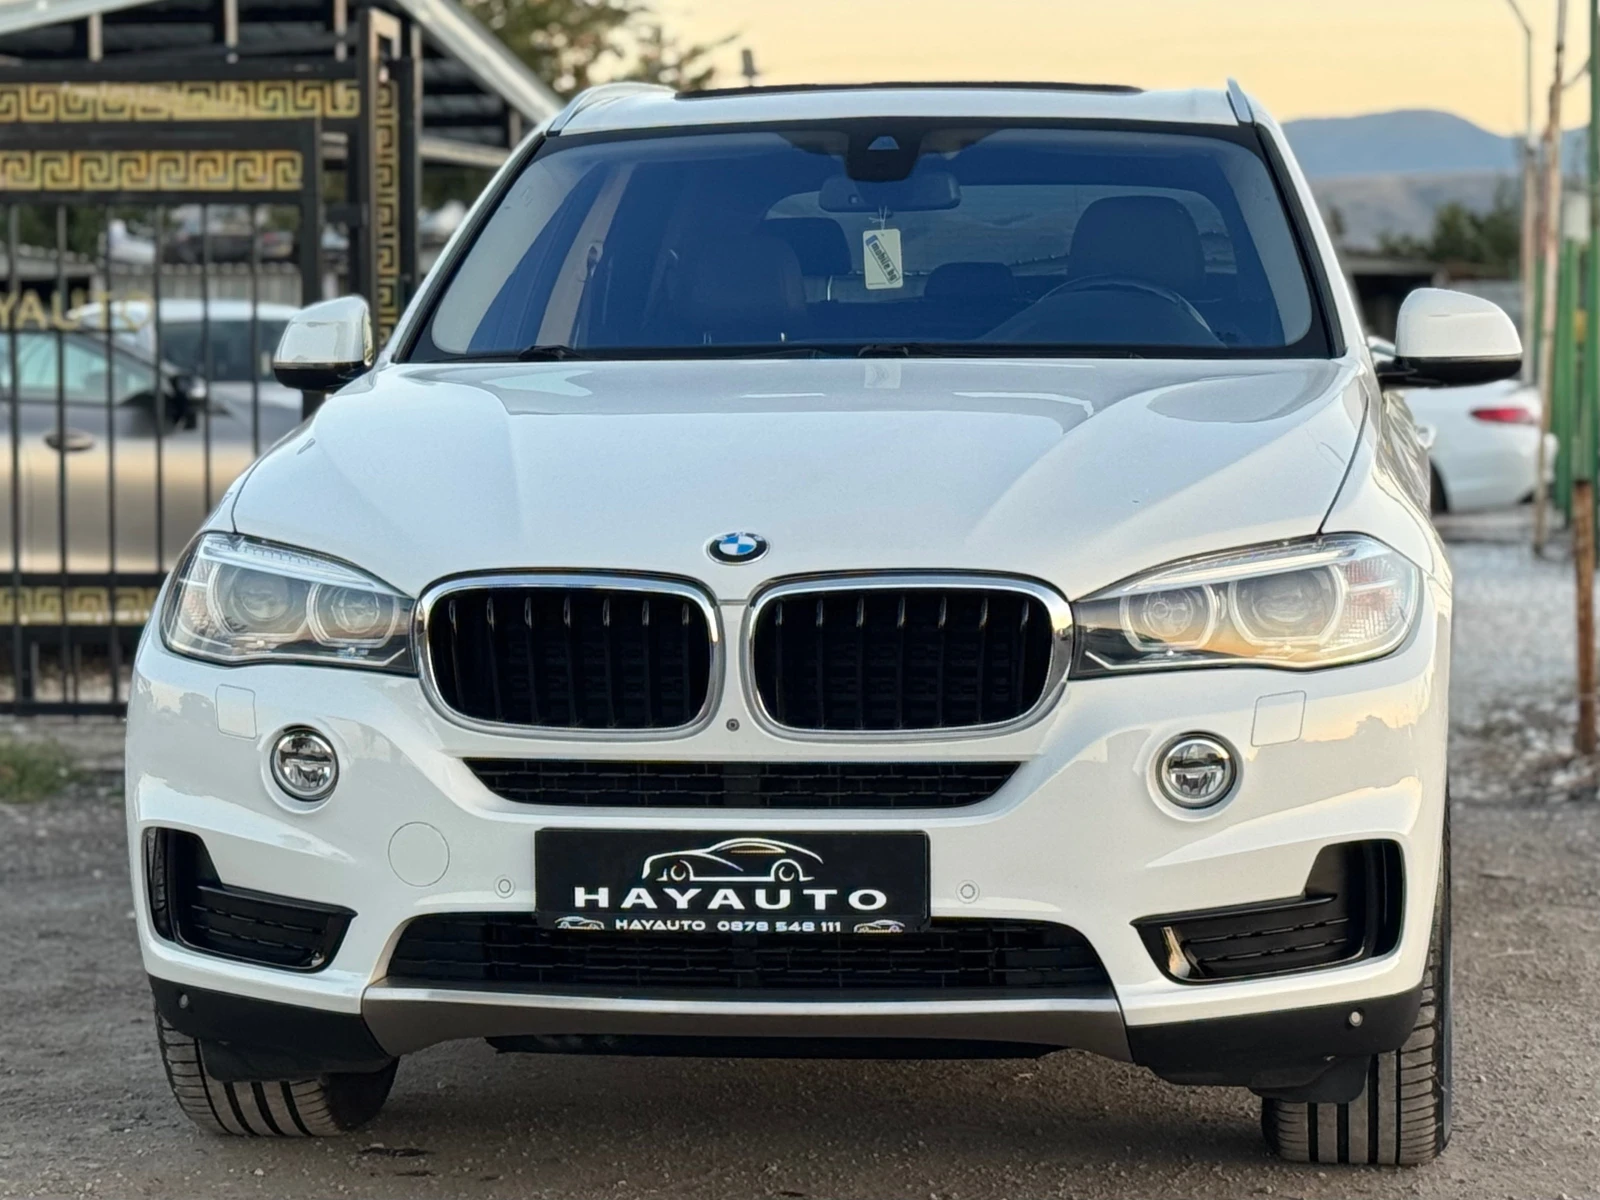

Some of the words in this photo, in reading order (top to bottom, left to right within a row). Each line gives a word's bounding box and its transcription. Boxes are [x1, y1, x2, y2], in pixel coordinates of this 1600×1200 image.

[574, 887, 887, 910] HAYAUTO
[615, 919, 706, 932] HAYAUTO
[717, 920, 769, 932] 0878
[775, 921, 815, 932] 548
[821, 921, 841, 932] 111
